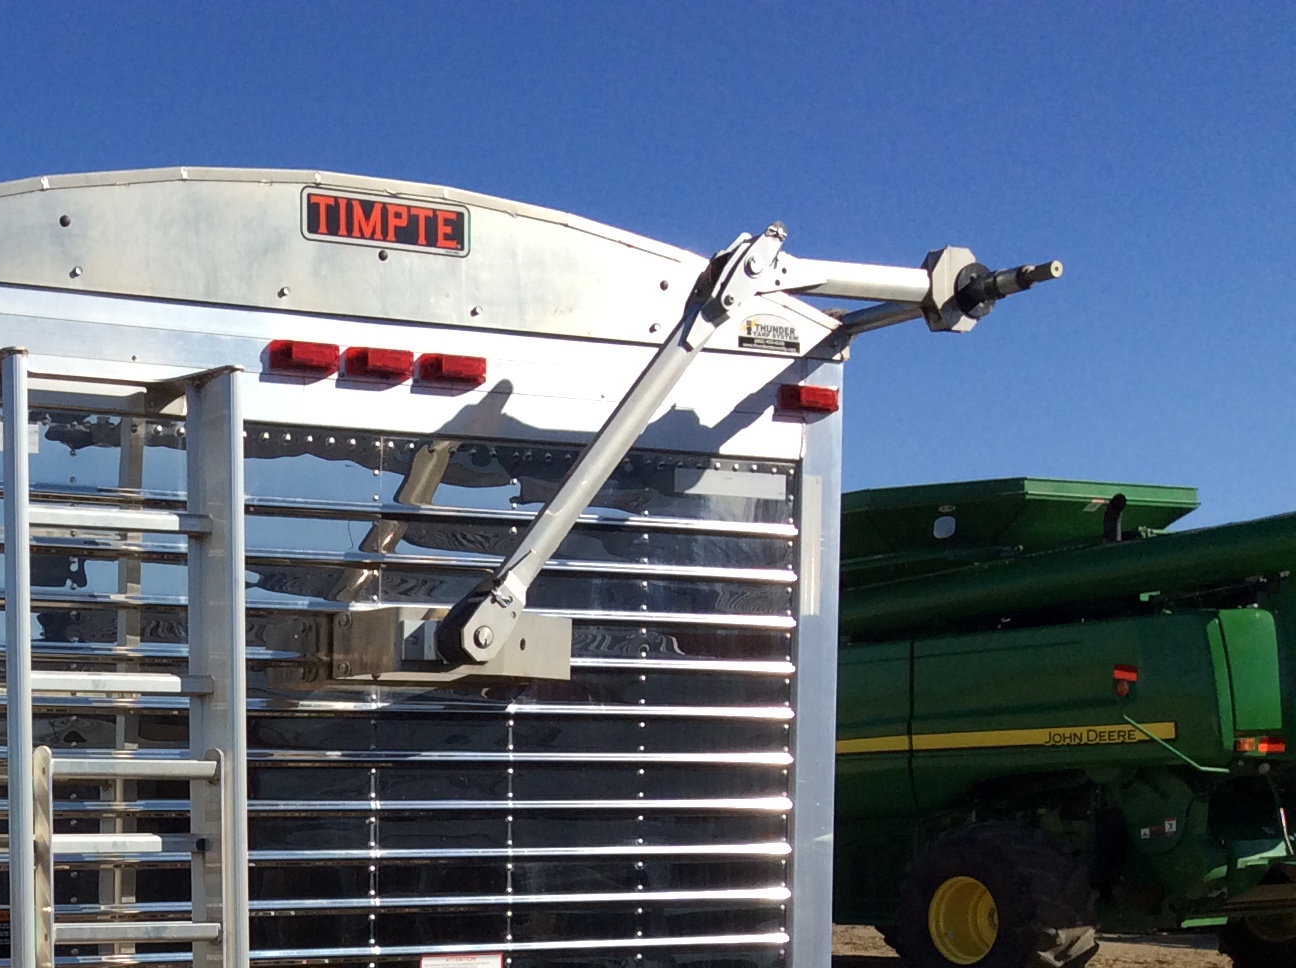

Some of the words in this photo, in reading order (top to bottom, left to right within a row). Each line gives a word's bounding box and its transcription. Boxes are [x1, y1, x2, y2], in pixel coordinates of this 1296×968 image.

[309, 193, 459, 249] TIMPTE
[754, 323, 796, 336] THUNDER
[773, 332, 799, 341] SYSTEM
[1044, 731, 1083, 744] JOHN
[1086, 729, 1137, 742] DEERE
